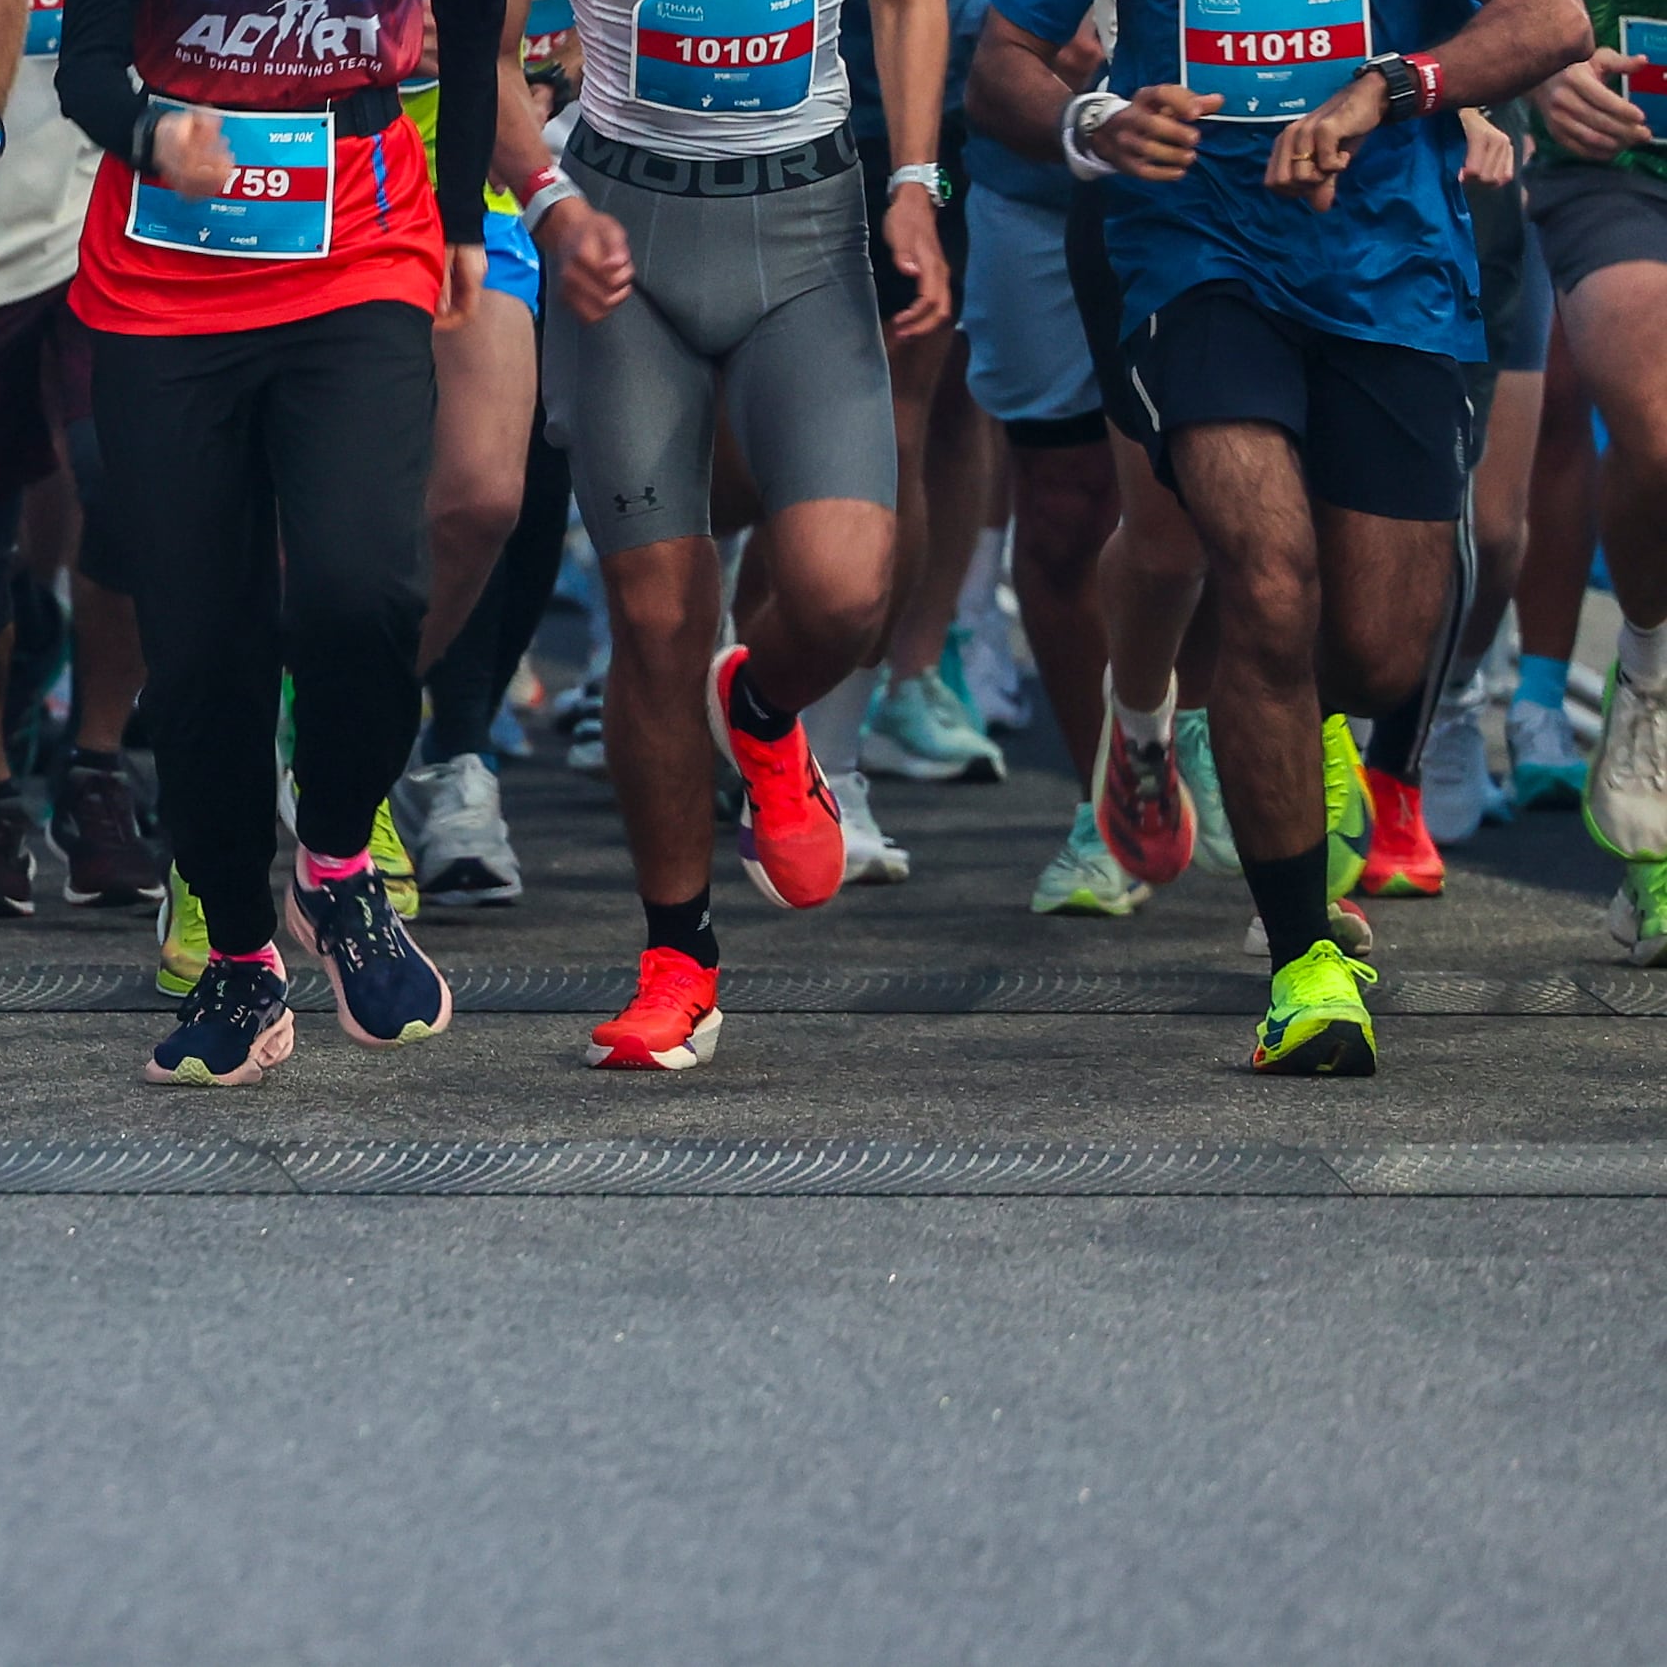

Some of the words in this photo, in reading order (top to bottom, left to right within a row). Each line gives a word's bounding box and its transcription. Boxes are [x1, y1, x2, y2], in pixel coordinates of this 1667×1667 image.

[676, 32, 789, 64] 10107
[1217, 30, 1332, 62] 11018
[209, 57, 258, 75] DHABI
[263, 62, 334, 78] RUNNING
[338, 56, 383, 73] TEAM
[269, 133, 293, 143] YAS
[294, 132, 315, 143] 10K
[569, 129, 825, 196] MOUR
[222, 167, 290, 198] 759
